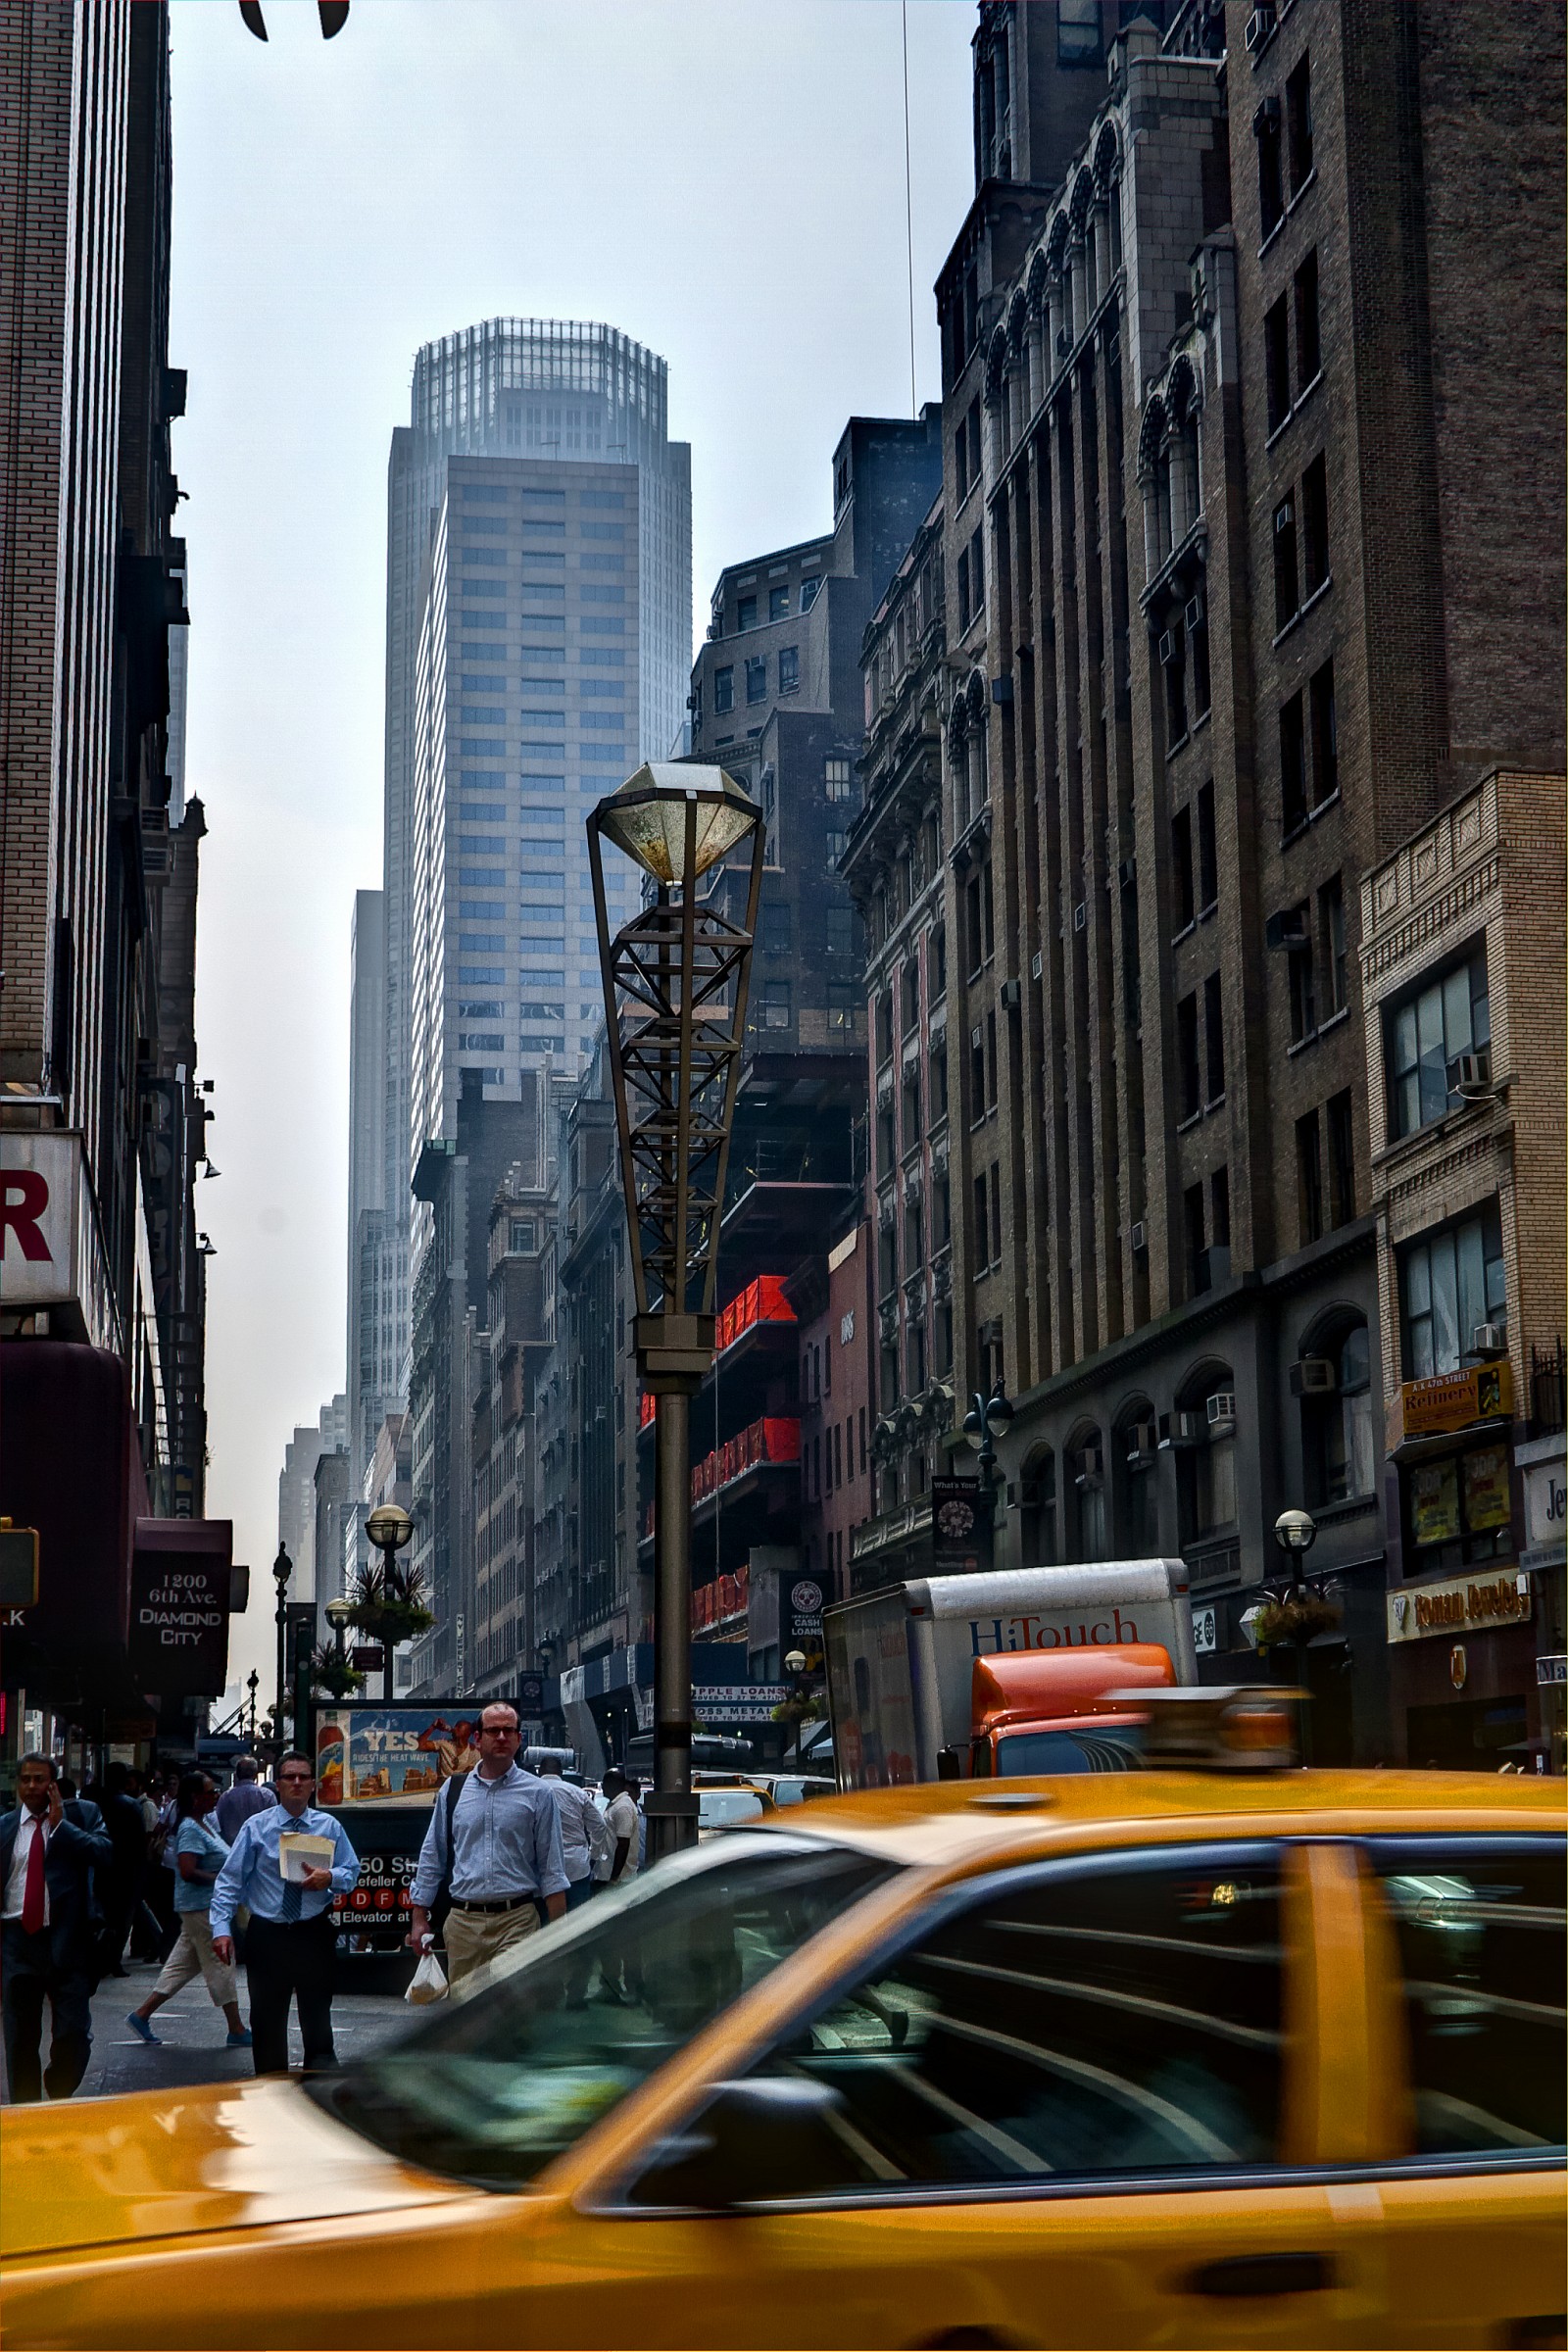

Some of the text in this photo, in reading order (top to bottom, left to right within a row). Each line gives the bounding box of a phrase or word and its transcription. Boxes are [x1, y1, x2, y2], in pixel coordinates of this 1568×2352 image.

[1445, 1371, 1471, 1386] STREET
[1405, 1385, 1476, 1411] Refinery
[1546, 1478, 1567, 1521] Je
[164, 1574, 208, 1589] 1200
[149, 1589, 218, 1604] 6th Ave.
[139, 1608, 222, 1626] DIAMOND
[1415, 1592, 1464, 1627] Roman
[161, 1629, 203, 1645] CITY
[968, 1608, 1142, 1657] HiTouch
[694, 1707, 723, 1716] OSS
[364, 1731, 419, 1751] YES
[390, 1753, 408, 1762] HEAT
[360, 1857, 384, 1873] 50
[356, 1893, 367, 1905] D
[380, 1893, 388, 1905] F
[343, 1911, 410, 1923] Elevator at
